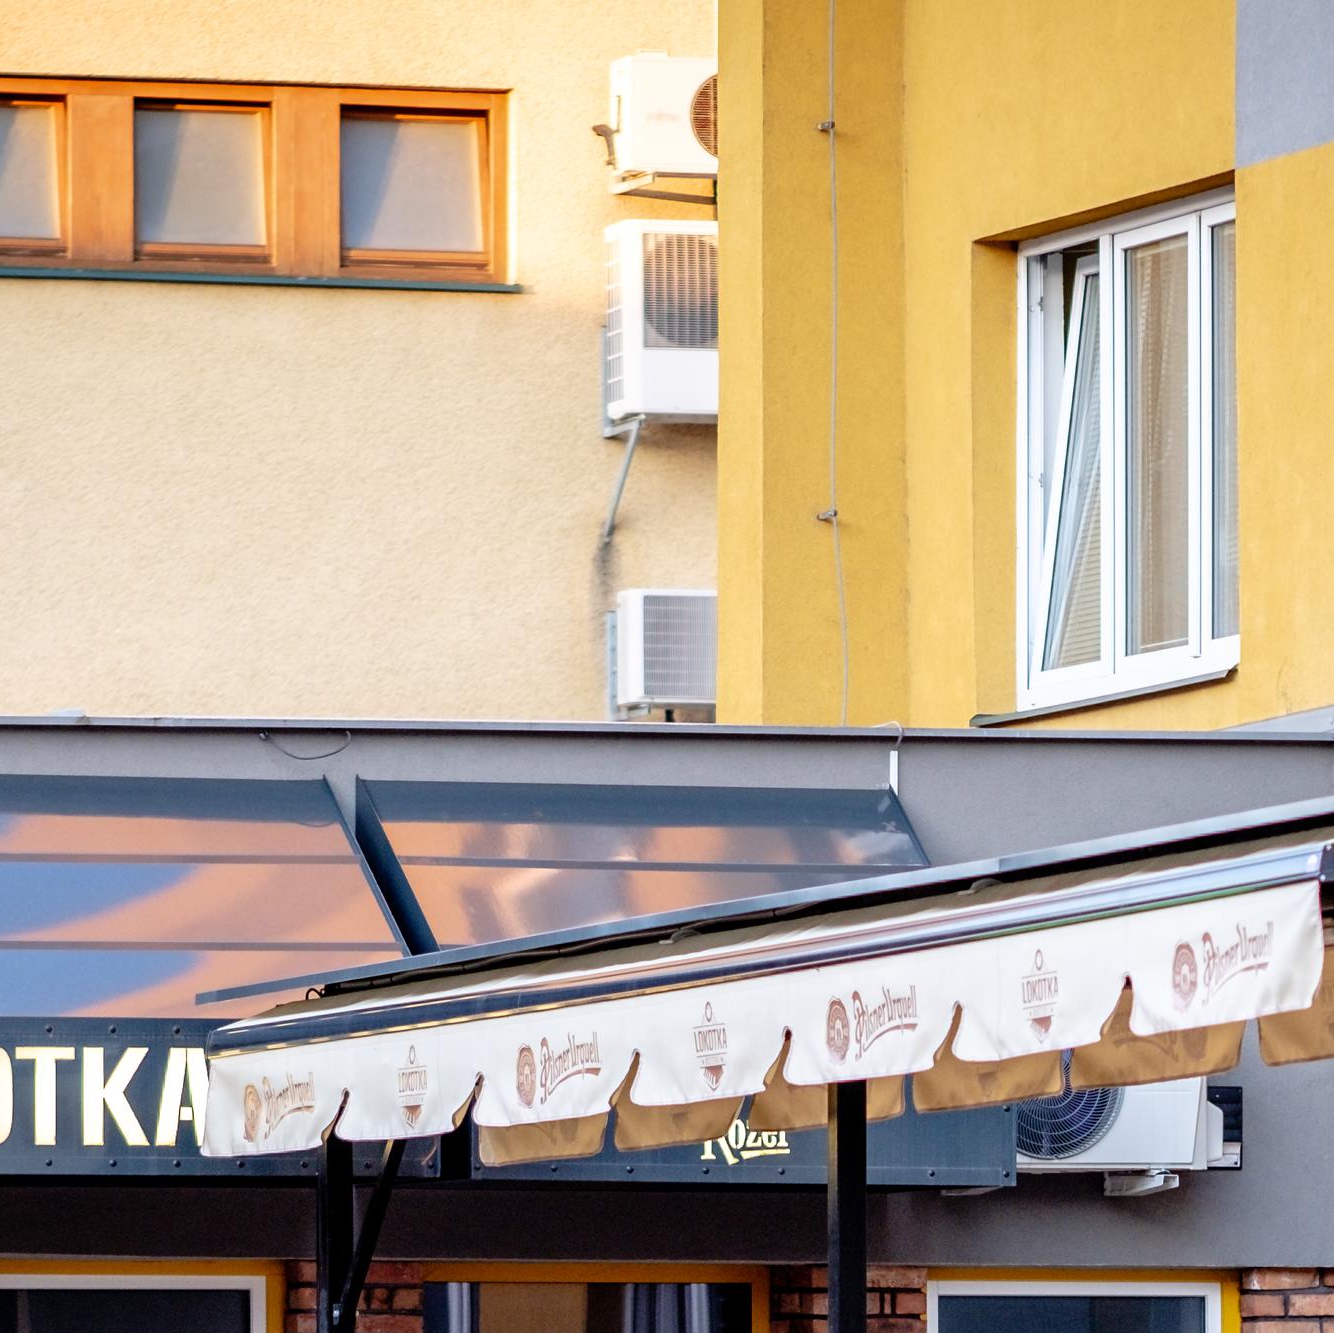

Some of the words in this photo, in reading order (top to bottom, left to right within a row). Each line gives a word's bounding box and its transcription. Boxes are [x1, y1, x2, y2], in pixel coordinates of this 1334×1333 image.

[1021, 975, 1059, 1005] LOKOTKA
[851, 989, 887, 1061] Pilsner
[882, 984, 917, 1035] Urquell
[693, 1026, 728, 1053] LOKOTKA
[398, 1069, 428, 1095] LOKOTKA
[540, 1036, 570, 1105] Pilsner
[567, 1031, 601, 1080] Urquell
